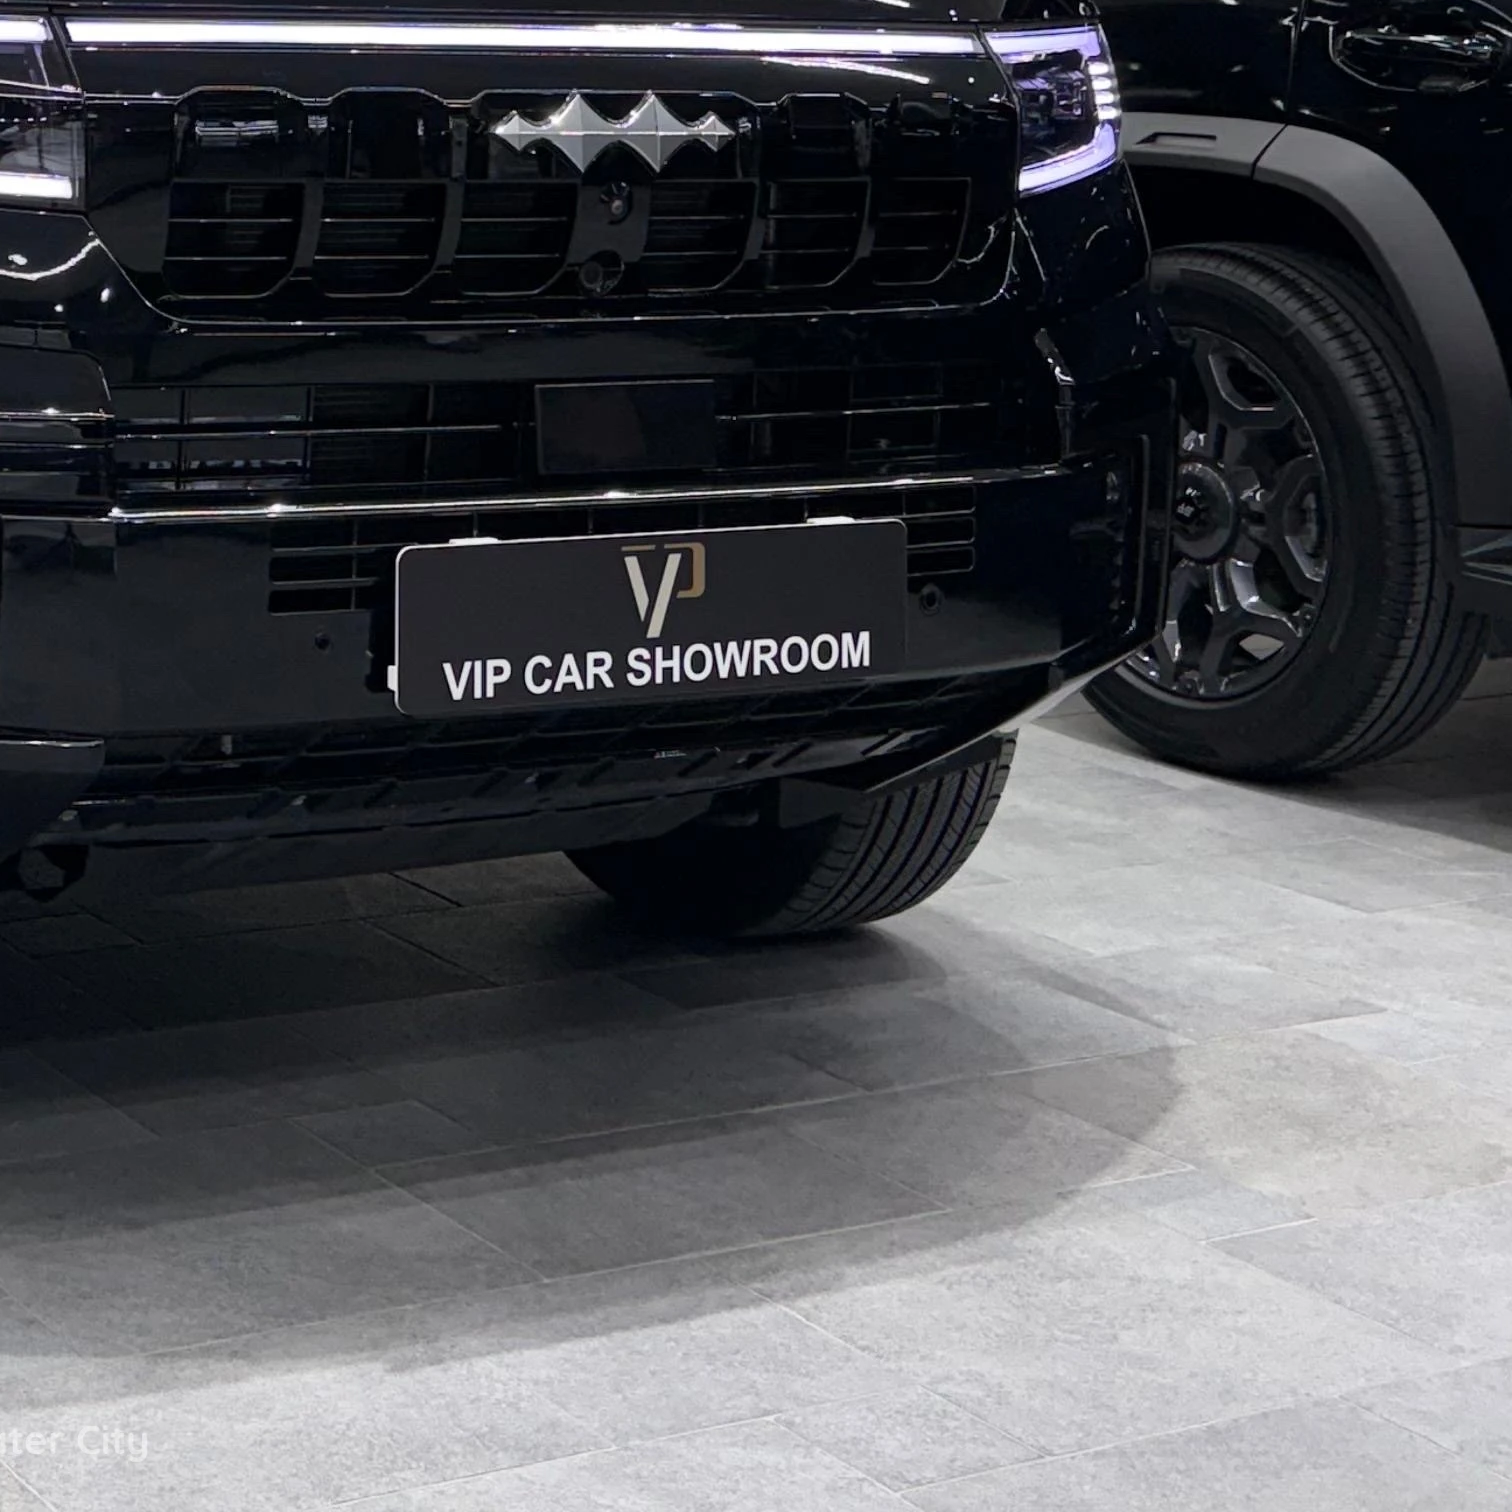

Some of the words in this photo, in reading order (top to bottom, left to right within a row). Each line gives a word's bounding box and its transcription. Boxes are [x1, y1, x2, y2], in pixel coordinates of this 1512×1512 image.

[442, 659, 512, 701] VIP
[523, 651, 615, 694] CAR
[626, 630, 871, 687] SHOWROOM
